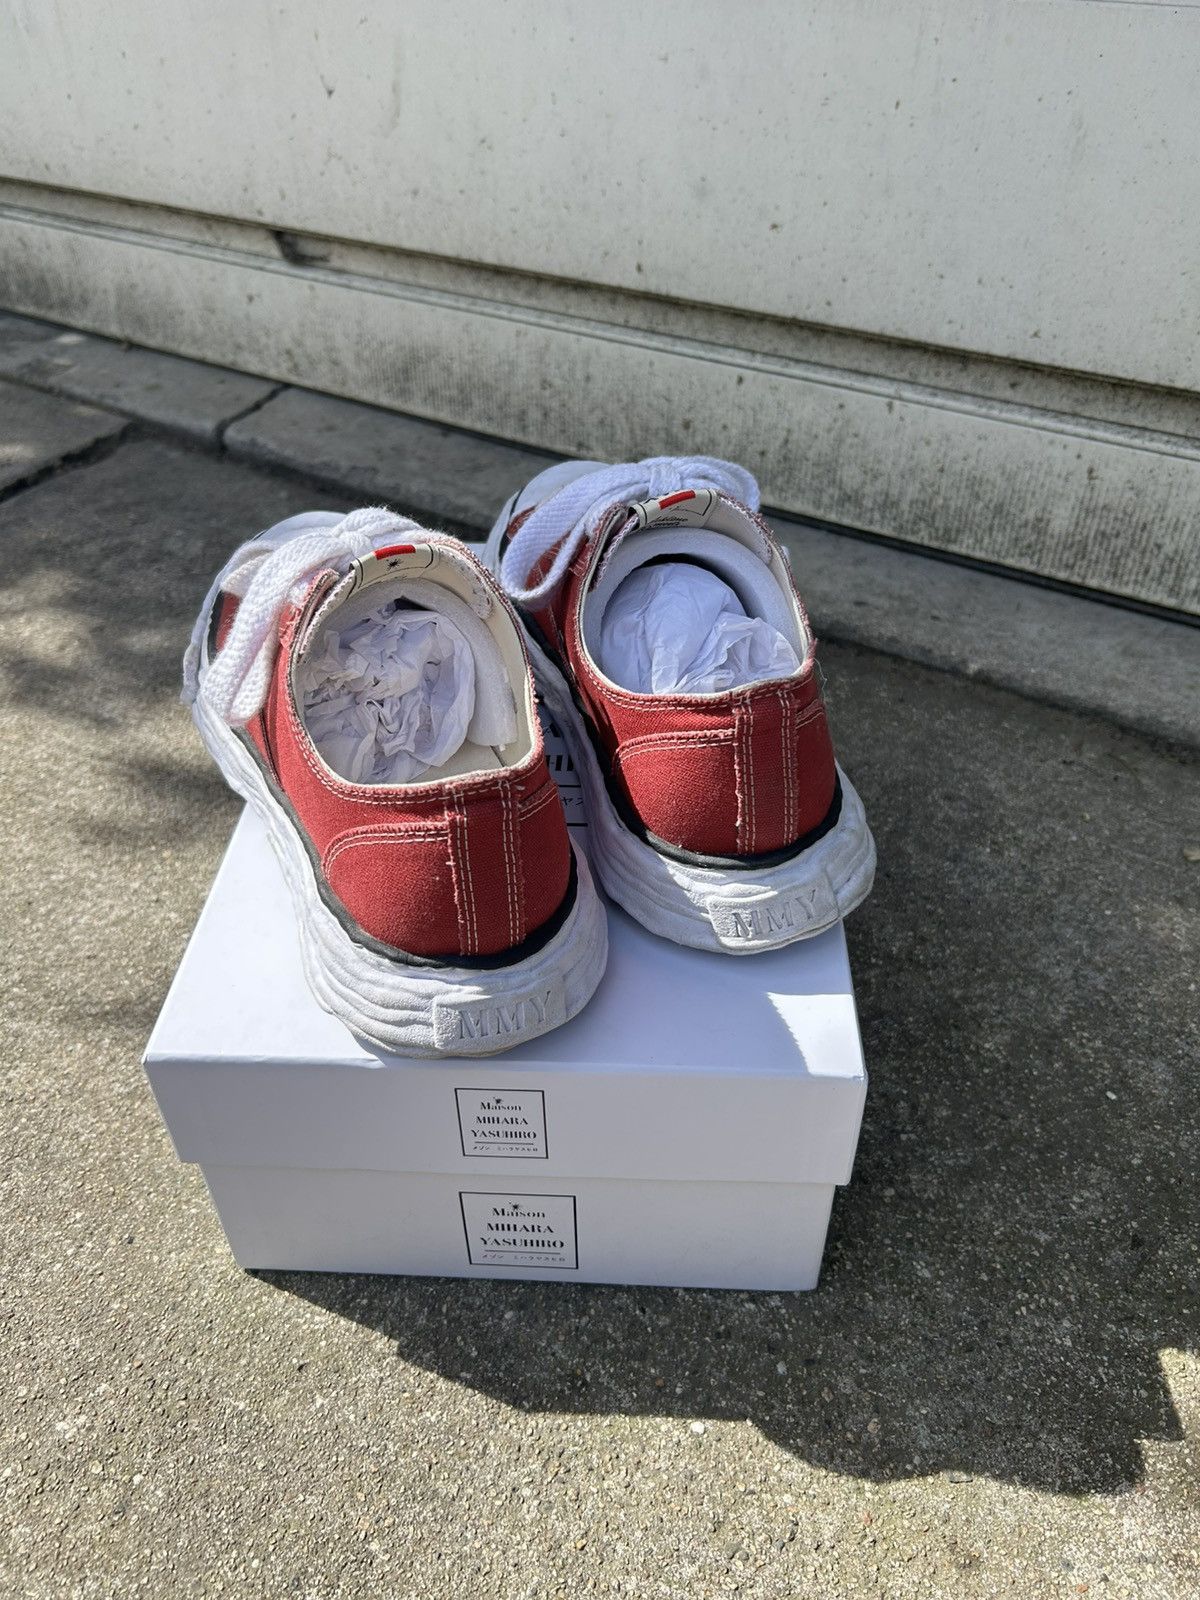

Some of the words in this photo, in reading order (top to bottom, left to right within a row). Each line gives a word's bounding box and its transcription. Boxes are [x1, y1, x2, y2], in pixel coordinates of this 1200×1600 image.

[731, 889, 816, 938] MMY
[458, 990, 551, 1040] MMY
[480, 1101, 522, 1111] Maison
[476, 1116, 529, 1125] MIHARA
[471, 1129, 537, 1139] YASUHIRO
[492, 1207, 546, 1218] Maison
[486, 1222, 554, 1233] MIHARA
[480, 1237, 565, 1249] YASUHIRO
